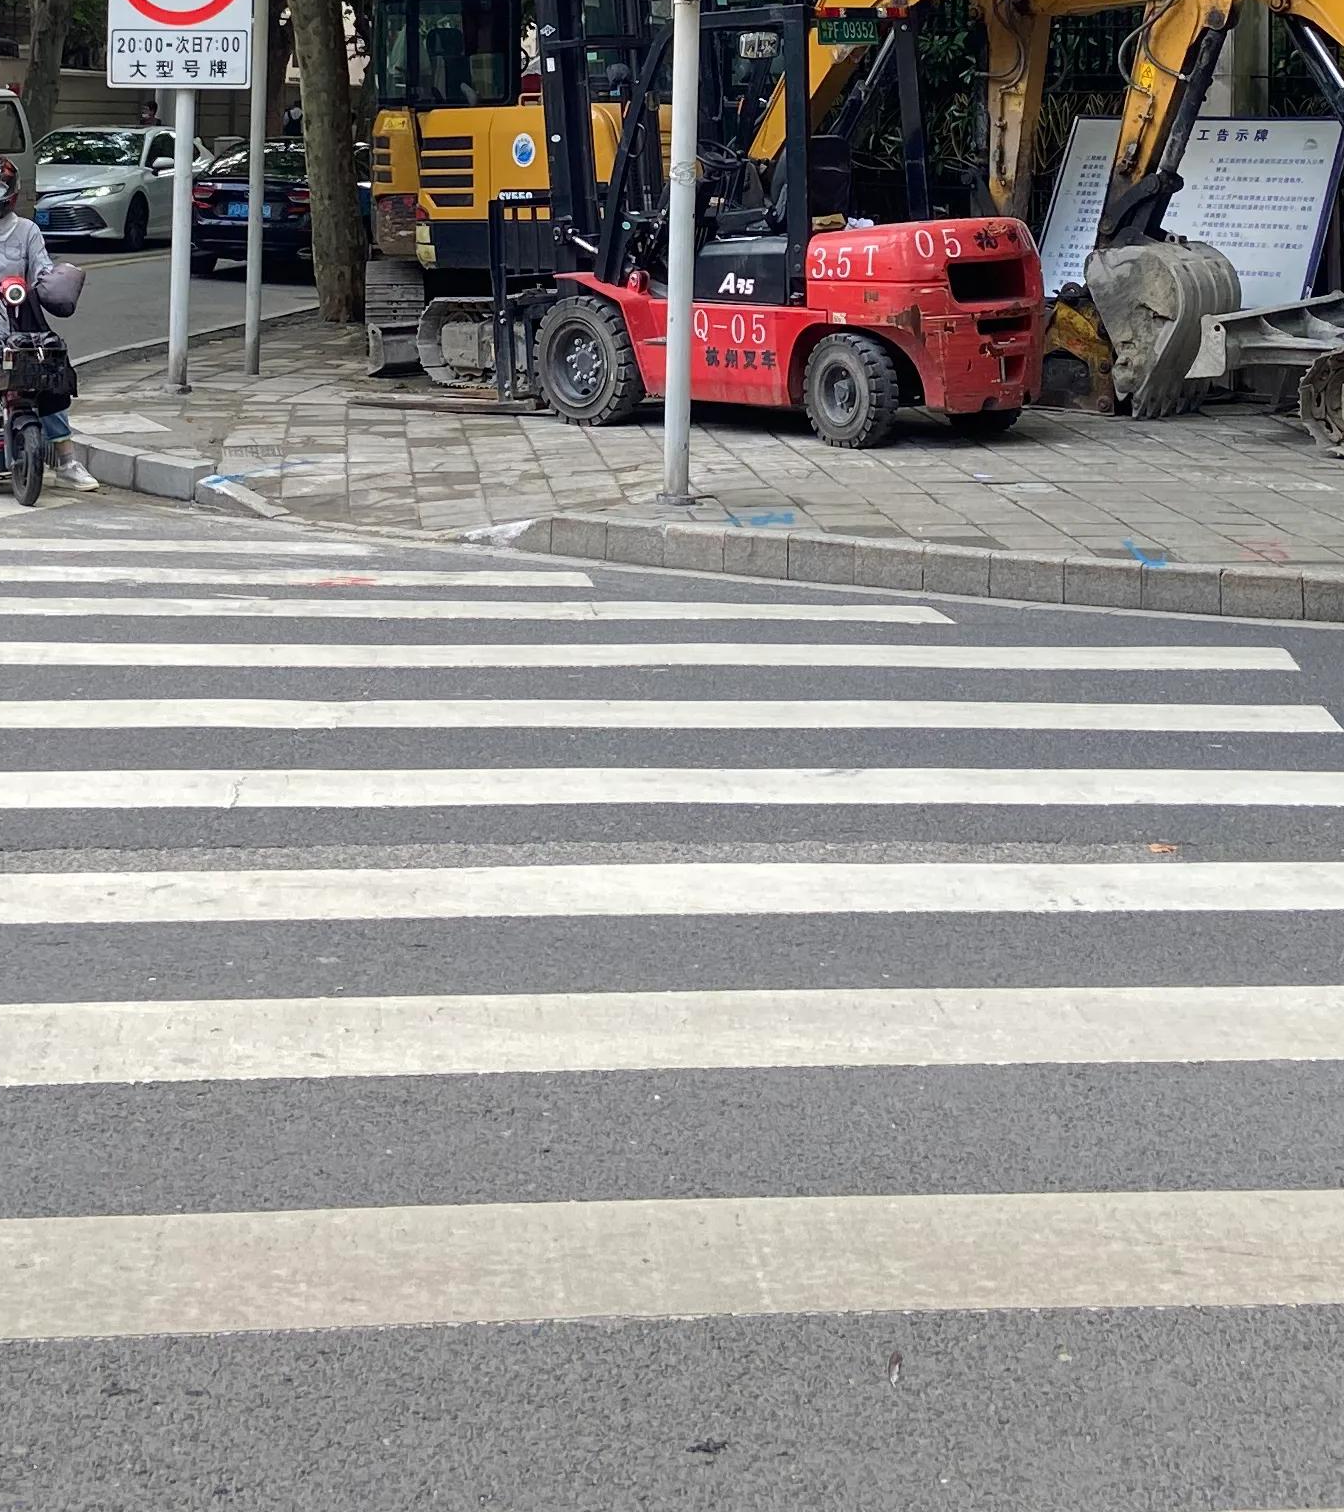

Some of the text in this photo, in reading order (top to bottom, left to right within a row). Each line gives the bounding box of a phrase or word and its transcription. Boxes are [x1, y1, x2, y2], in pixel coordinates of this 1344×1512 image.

[117, 36, 240, 54] 20:00-次日7:00
[129, 59, 227, 78] 大型号牌
[914, 228, 962, 258] 05
[693, 308, 766, 345] Q-05
[706, 346, 777, 371] 杭州叉车
